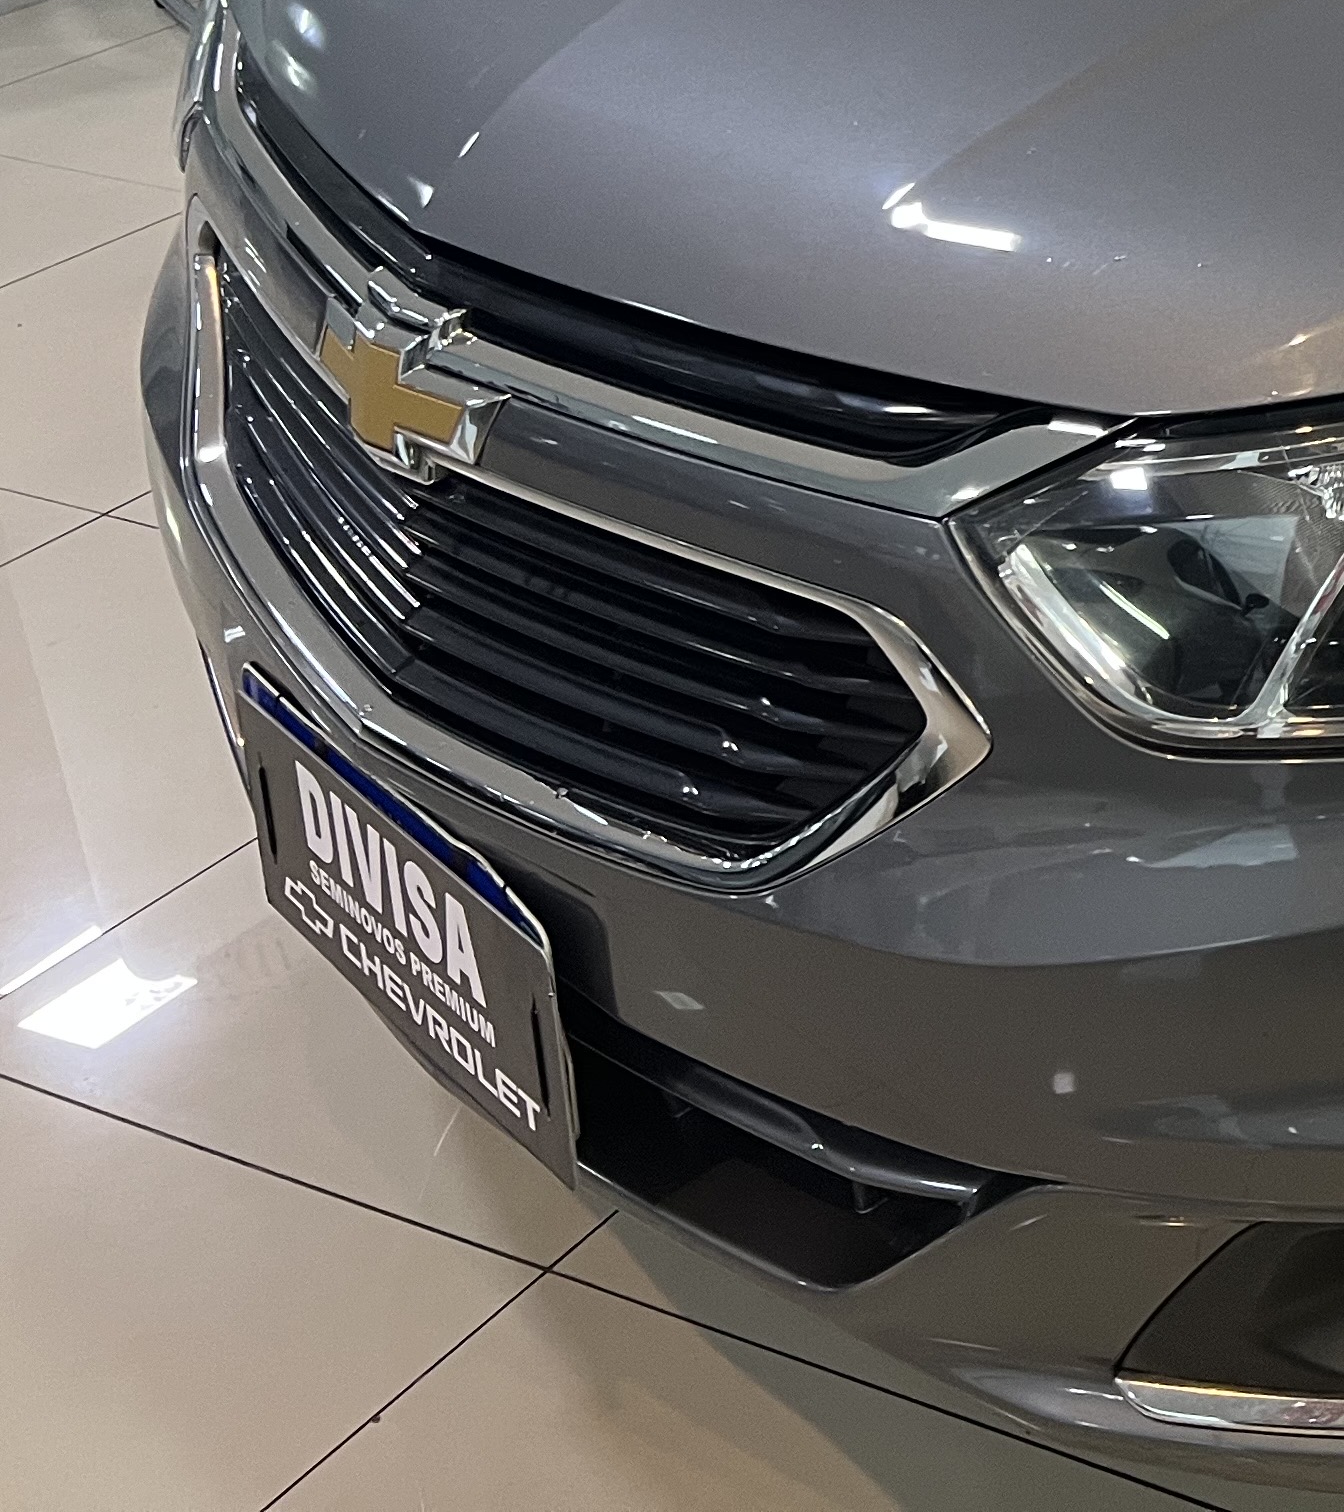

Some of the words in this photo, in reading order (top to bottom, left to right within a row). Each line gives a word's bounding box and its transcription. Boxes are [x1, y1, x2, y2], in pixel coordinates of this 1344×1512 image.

[296, 760, 487, 1008] DIVISA
[309, 859, 407, 964] SEMINOVOS
[410, 952, 497, 1047] PREMIUM
[340, 924, 540, 1130] CHEVROLET
